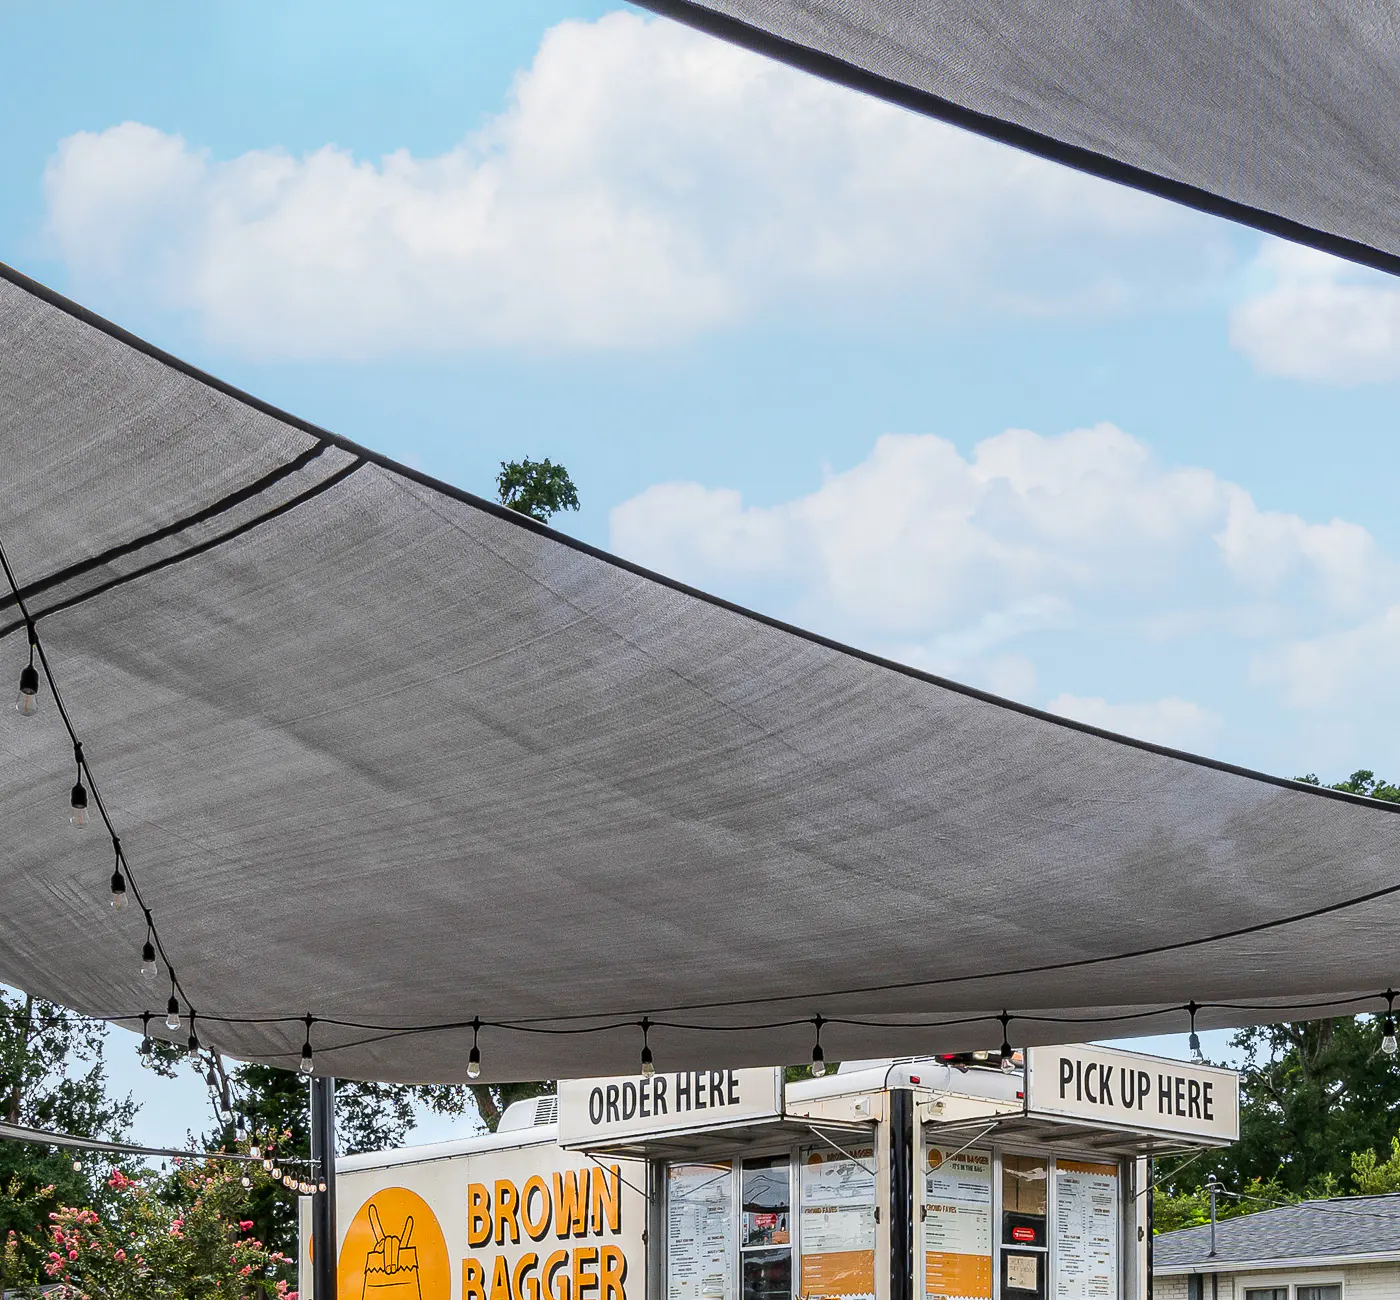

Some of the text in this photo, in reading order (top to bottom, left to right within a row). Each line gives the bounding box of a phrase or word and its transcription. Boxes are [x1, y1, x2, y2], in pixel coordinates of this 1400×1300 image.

[589, 1070, 740, 1125] ORDER HERE
[1060, 1057, 1214, 1121] PICK UP HERE
[468, 1164, 622, 1249] BROWN
